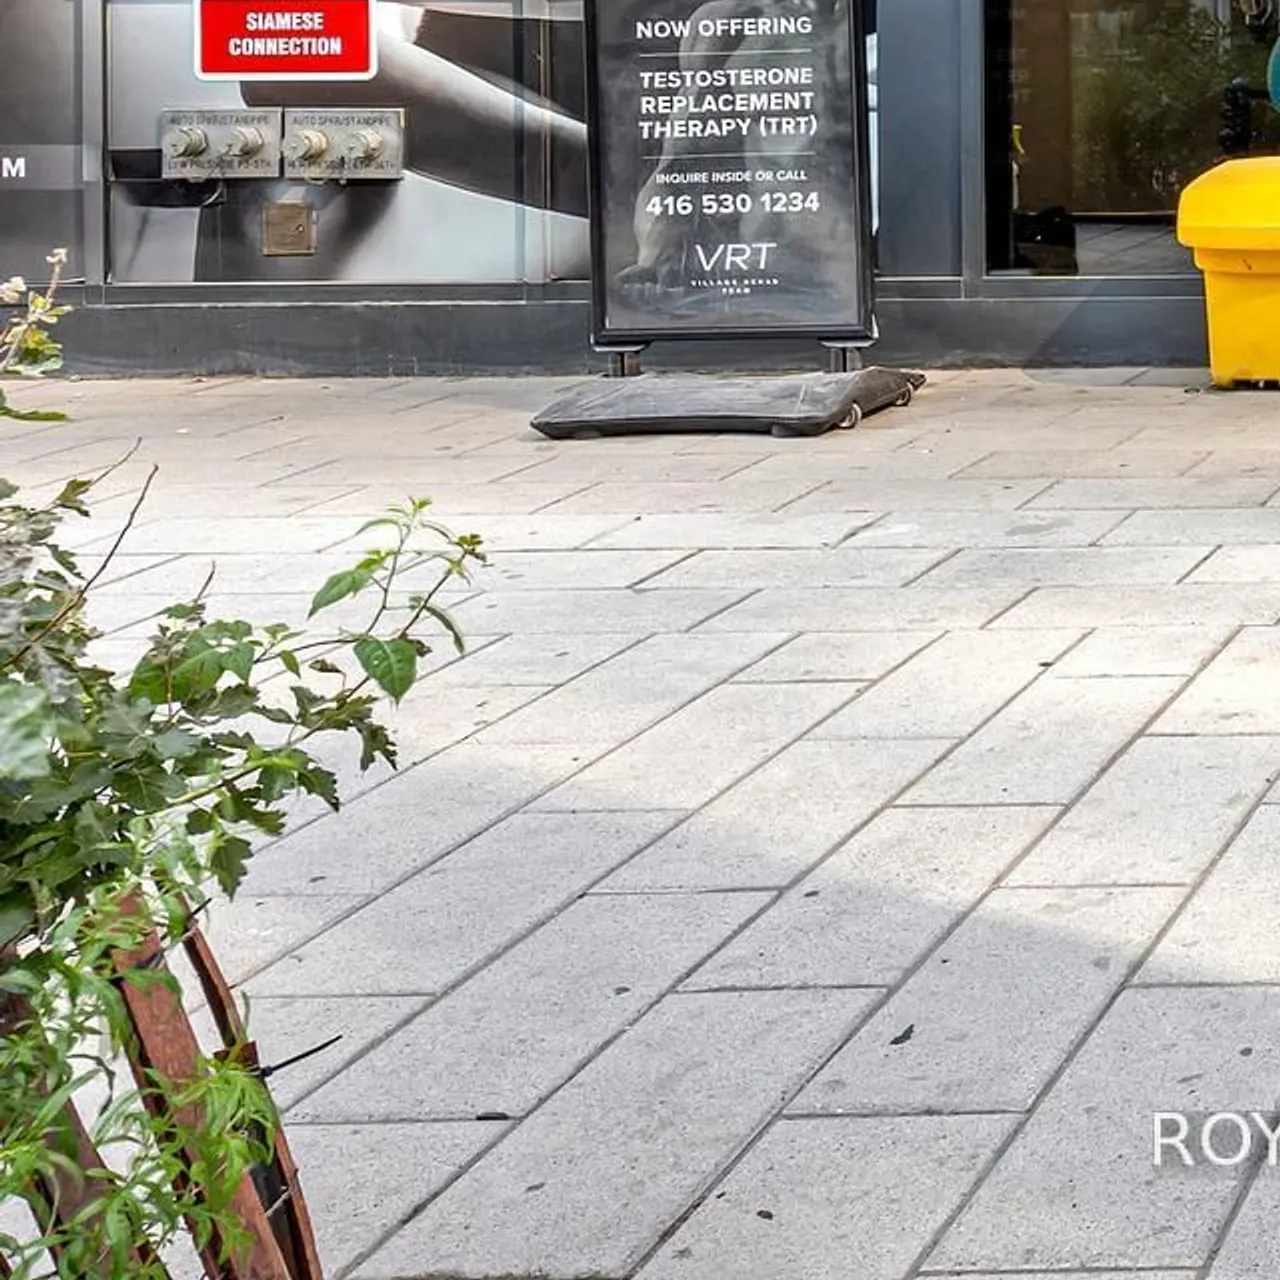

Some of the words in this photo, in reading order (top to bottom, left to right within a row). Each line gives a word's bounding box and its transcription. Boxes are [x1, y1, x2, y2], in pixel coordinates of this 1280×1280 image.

[245, 11, 325, 31] SIAMESE
[636, 20, 691, 39] NOW
[698, 16, 813, 37] OFFERING
[228, 36, 343, 56] CONNECTION
[640, 68, 813, 90] TESTOSTERONE
[641, 92, 815, 114] REPLACEMENT
[639, 118, 752, 140] THERAPY
[759, 114, 818, 138] (TRT)
[2, 157, 26, 178] M
[656, 172, 709, 184] INQUIRE
[712, 171, 752, 183] INSIDE
[755, 170, 774, 182] OR
[776, 170, 807, 182] CALL
[646, 195, 693, 216] 416
[701, 194, 753, 215] 530
[760, 192, 820, 213] 1234
[695, 242, 777, 272] VRT
